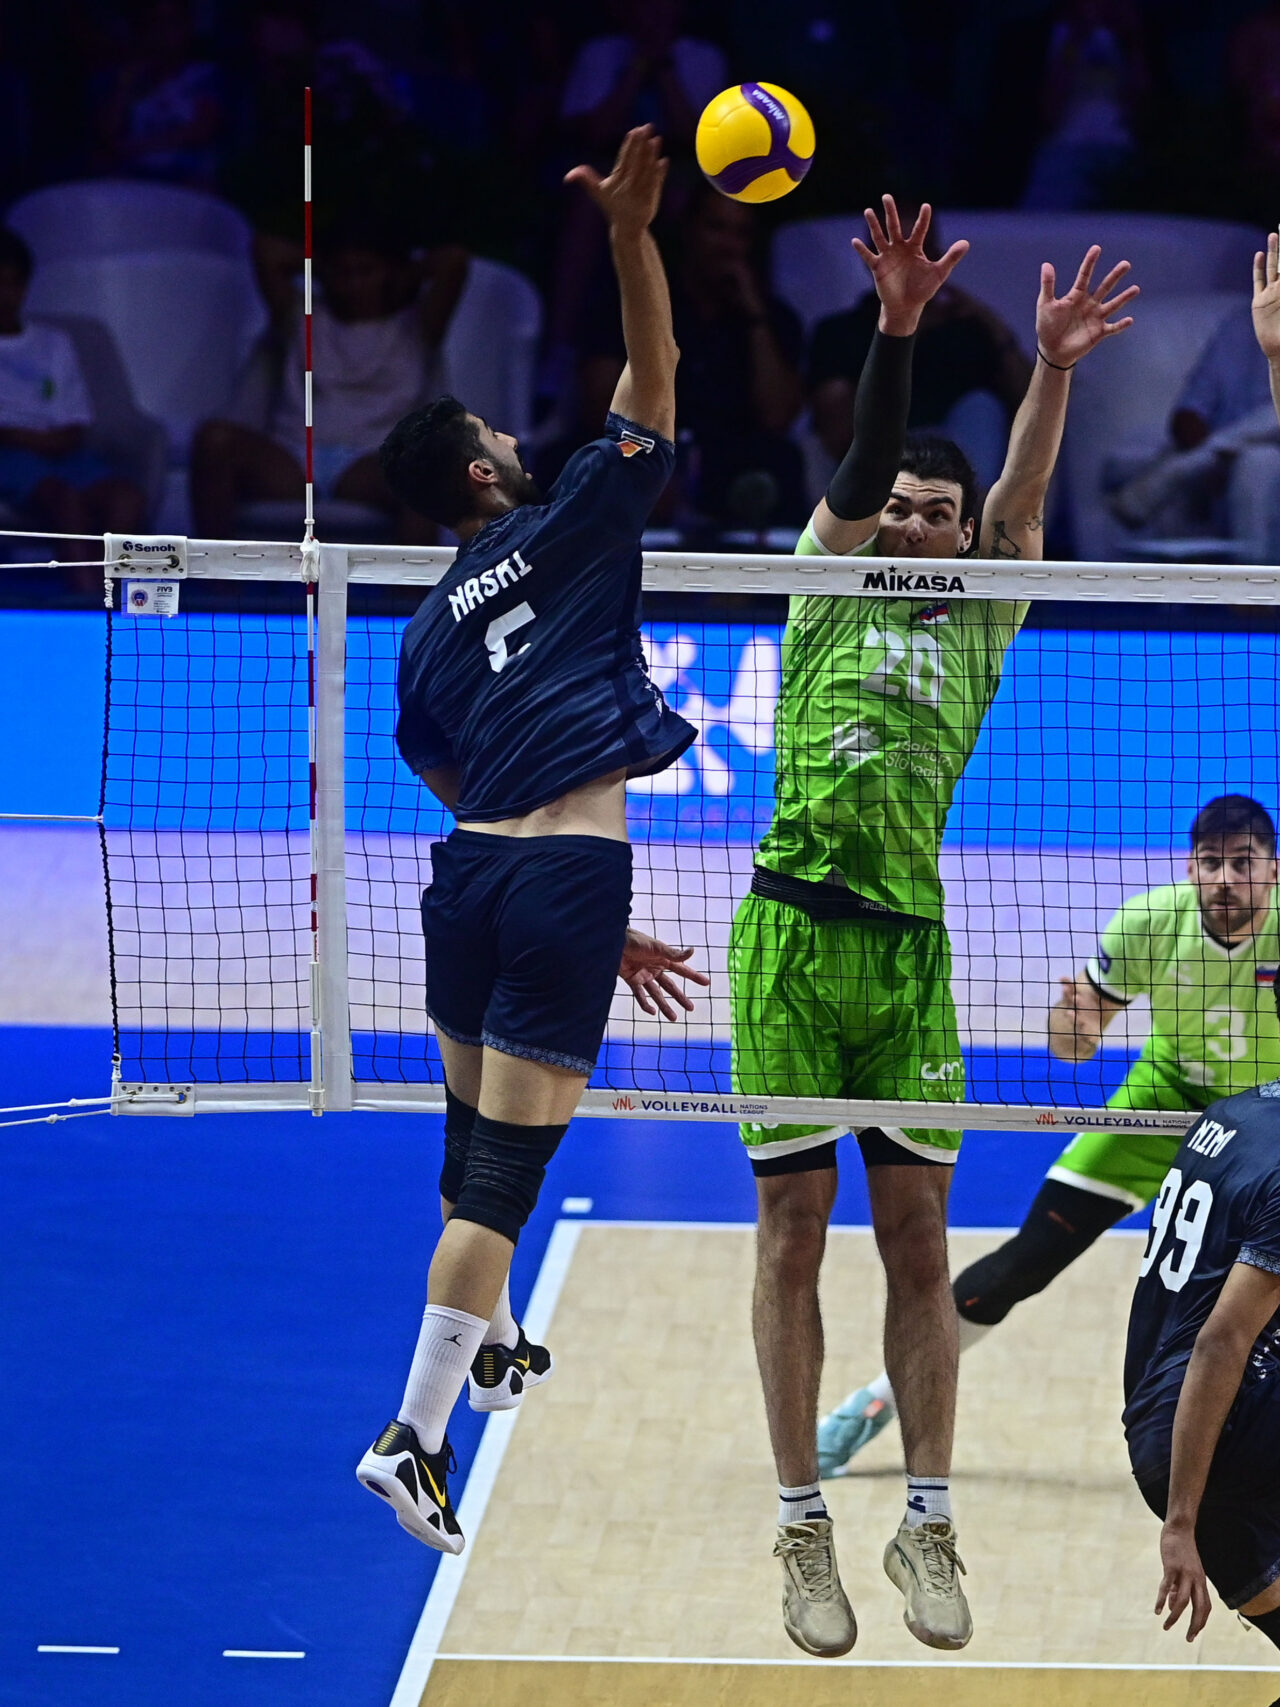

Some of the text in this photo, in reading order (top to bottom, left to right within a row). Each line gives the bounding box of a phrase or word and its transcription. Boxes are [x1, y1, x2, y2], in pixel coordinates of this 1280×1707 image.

[135, 543, 176, 552] Senoh
[448, 551, 533, 622] NASRI
[863, 566, 965, 593] MIKASA
[860, 627, 946, 710] 20
[1205, 1005, 1247, 1061] 3
[641, 1100, 737, 1114] VOLLEYBALL
[1064, 1116, 1160, 1128] VOLLEYBALL
[1139, 1167, 1214, 1292] 99
